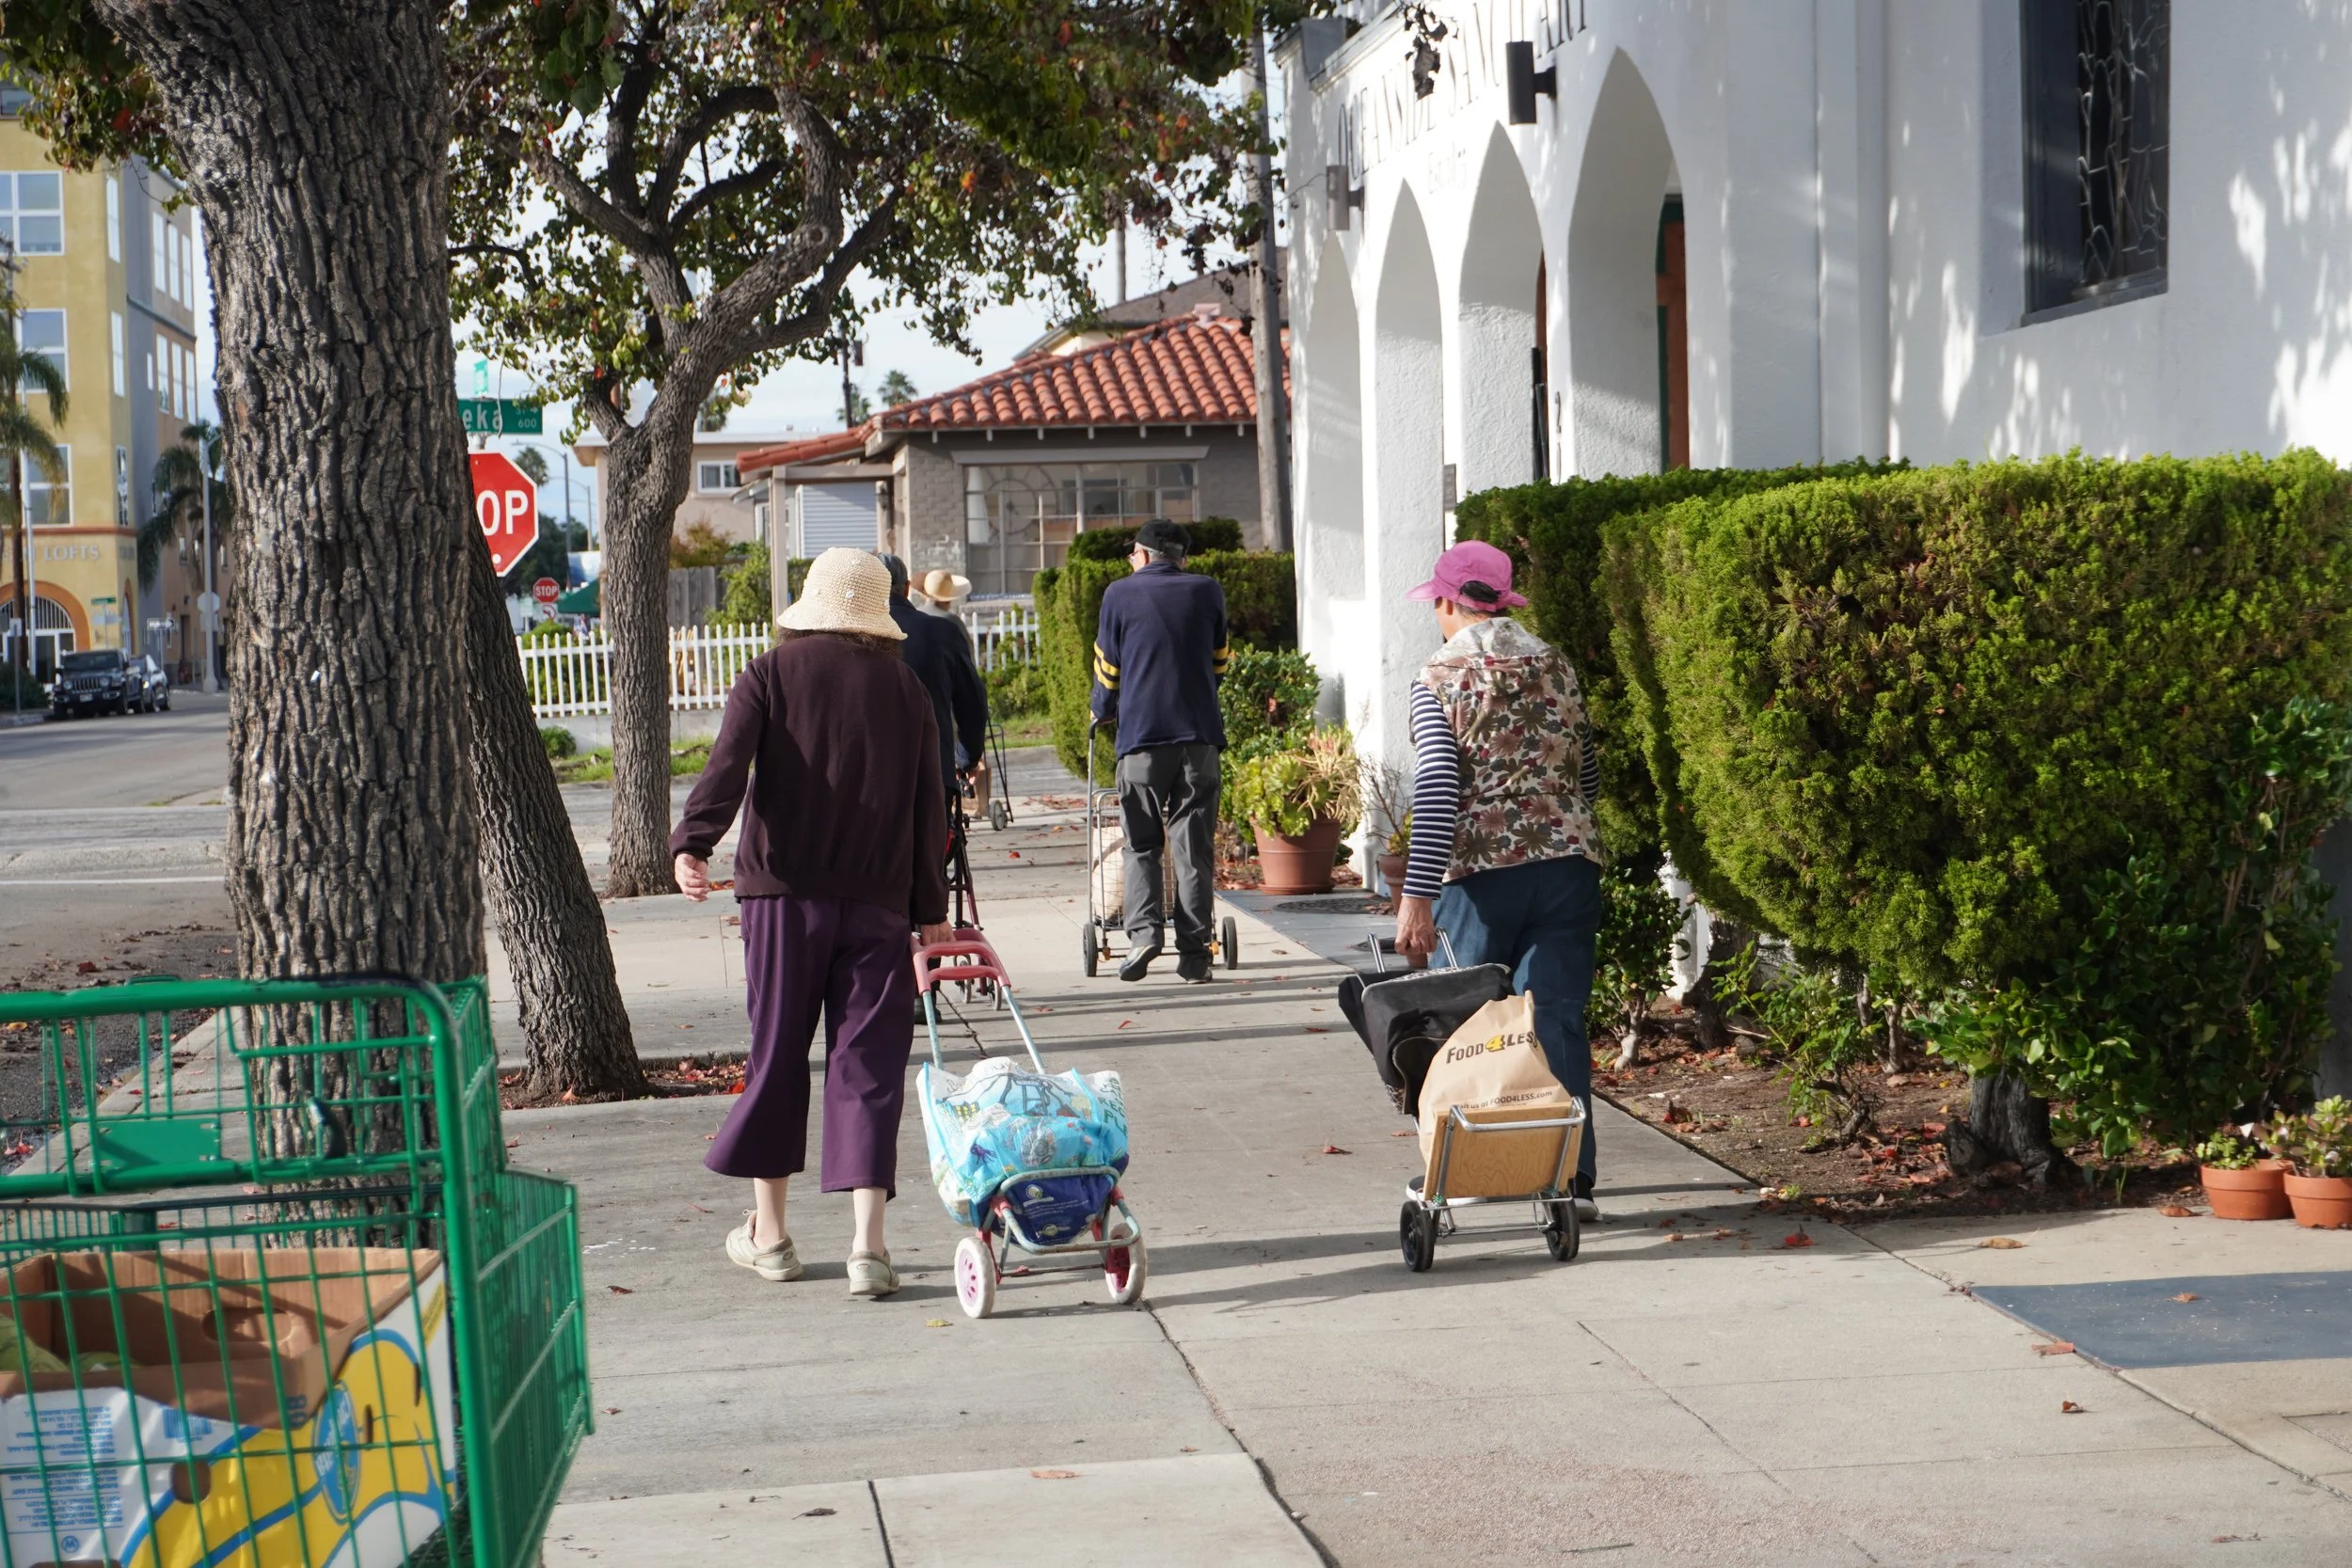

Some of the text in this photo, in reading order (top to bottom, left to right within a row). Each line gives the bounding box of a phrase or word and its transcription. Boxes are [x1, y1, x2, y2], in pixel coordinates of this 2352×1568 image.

[517, 418, 537, 429] 600
[476, 490, 529, 536] OP
[44, 545, 100, 562] LOFTS
[535, 586, 557, 596] STOP
[1489, 1090, 1552, 1106] FOOD4LESS.com
